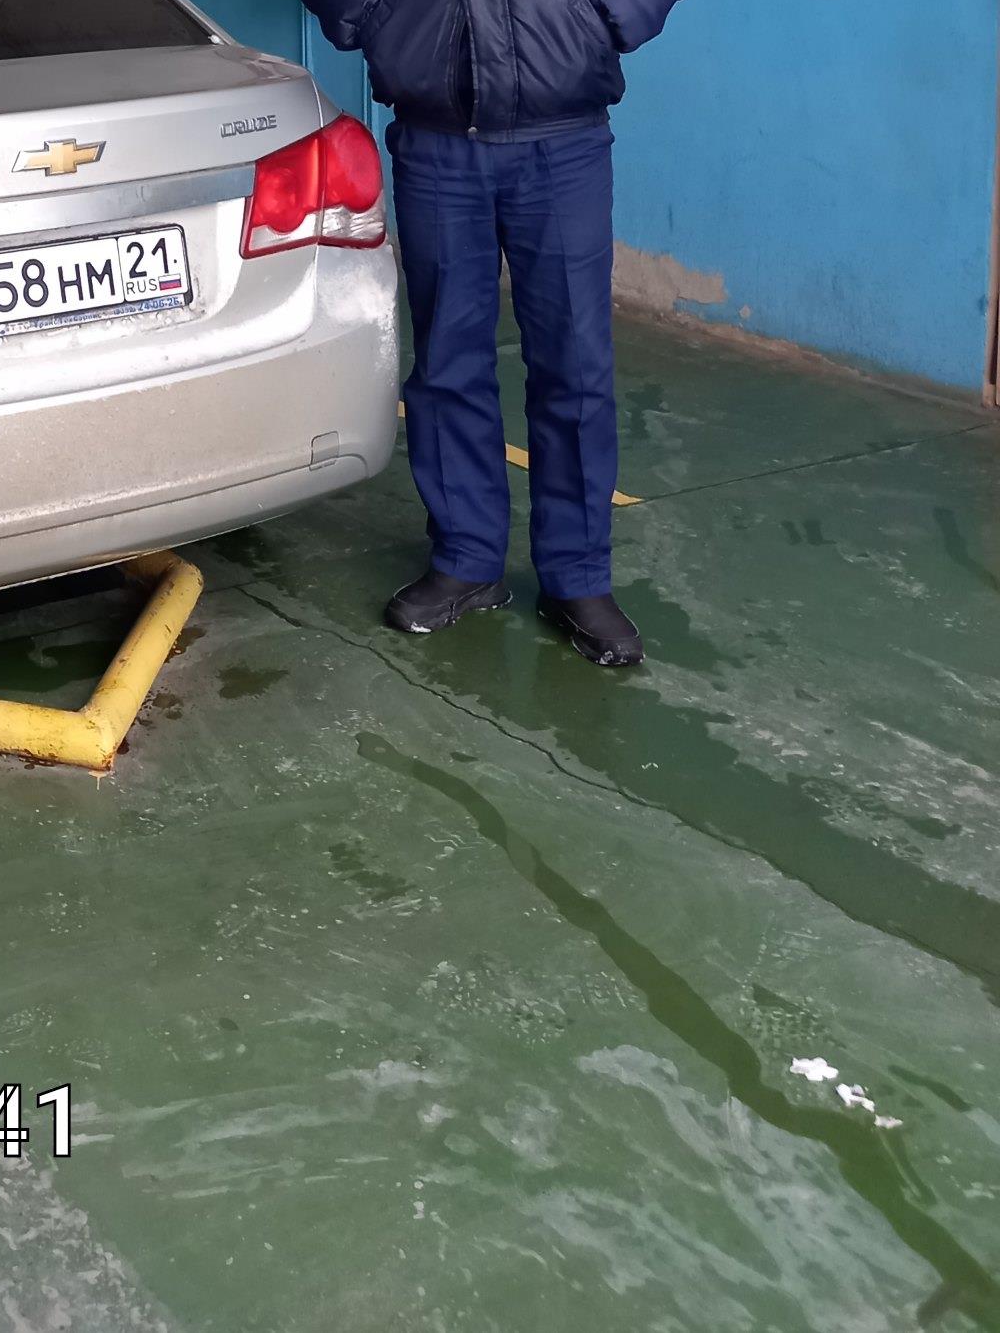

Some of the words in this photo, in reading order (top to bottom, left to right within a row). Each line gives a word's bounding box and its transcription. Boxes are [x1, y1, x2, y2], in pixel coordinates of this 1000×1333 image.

[220, 114, 278, 138] CRUZE
[126, 237, 172, 278] 21
[126, 278, 157, 296] RUS
